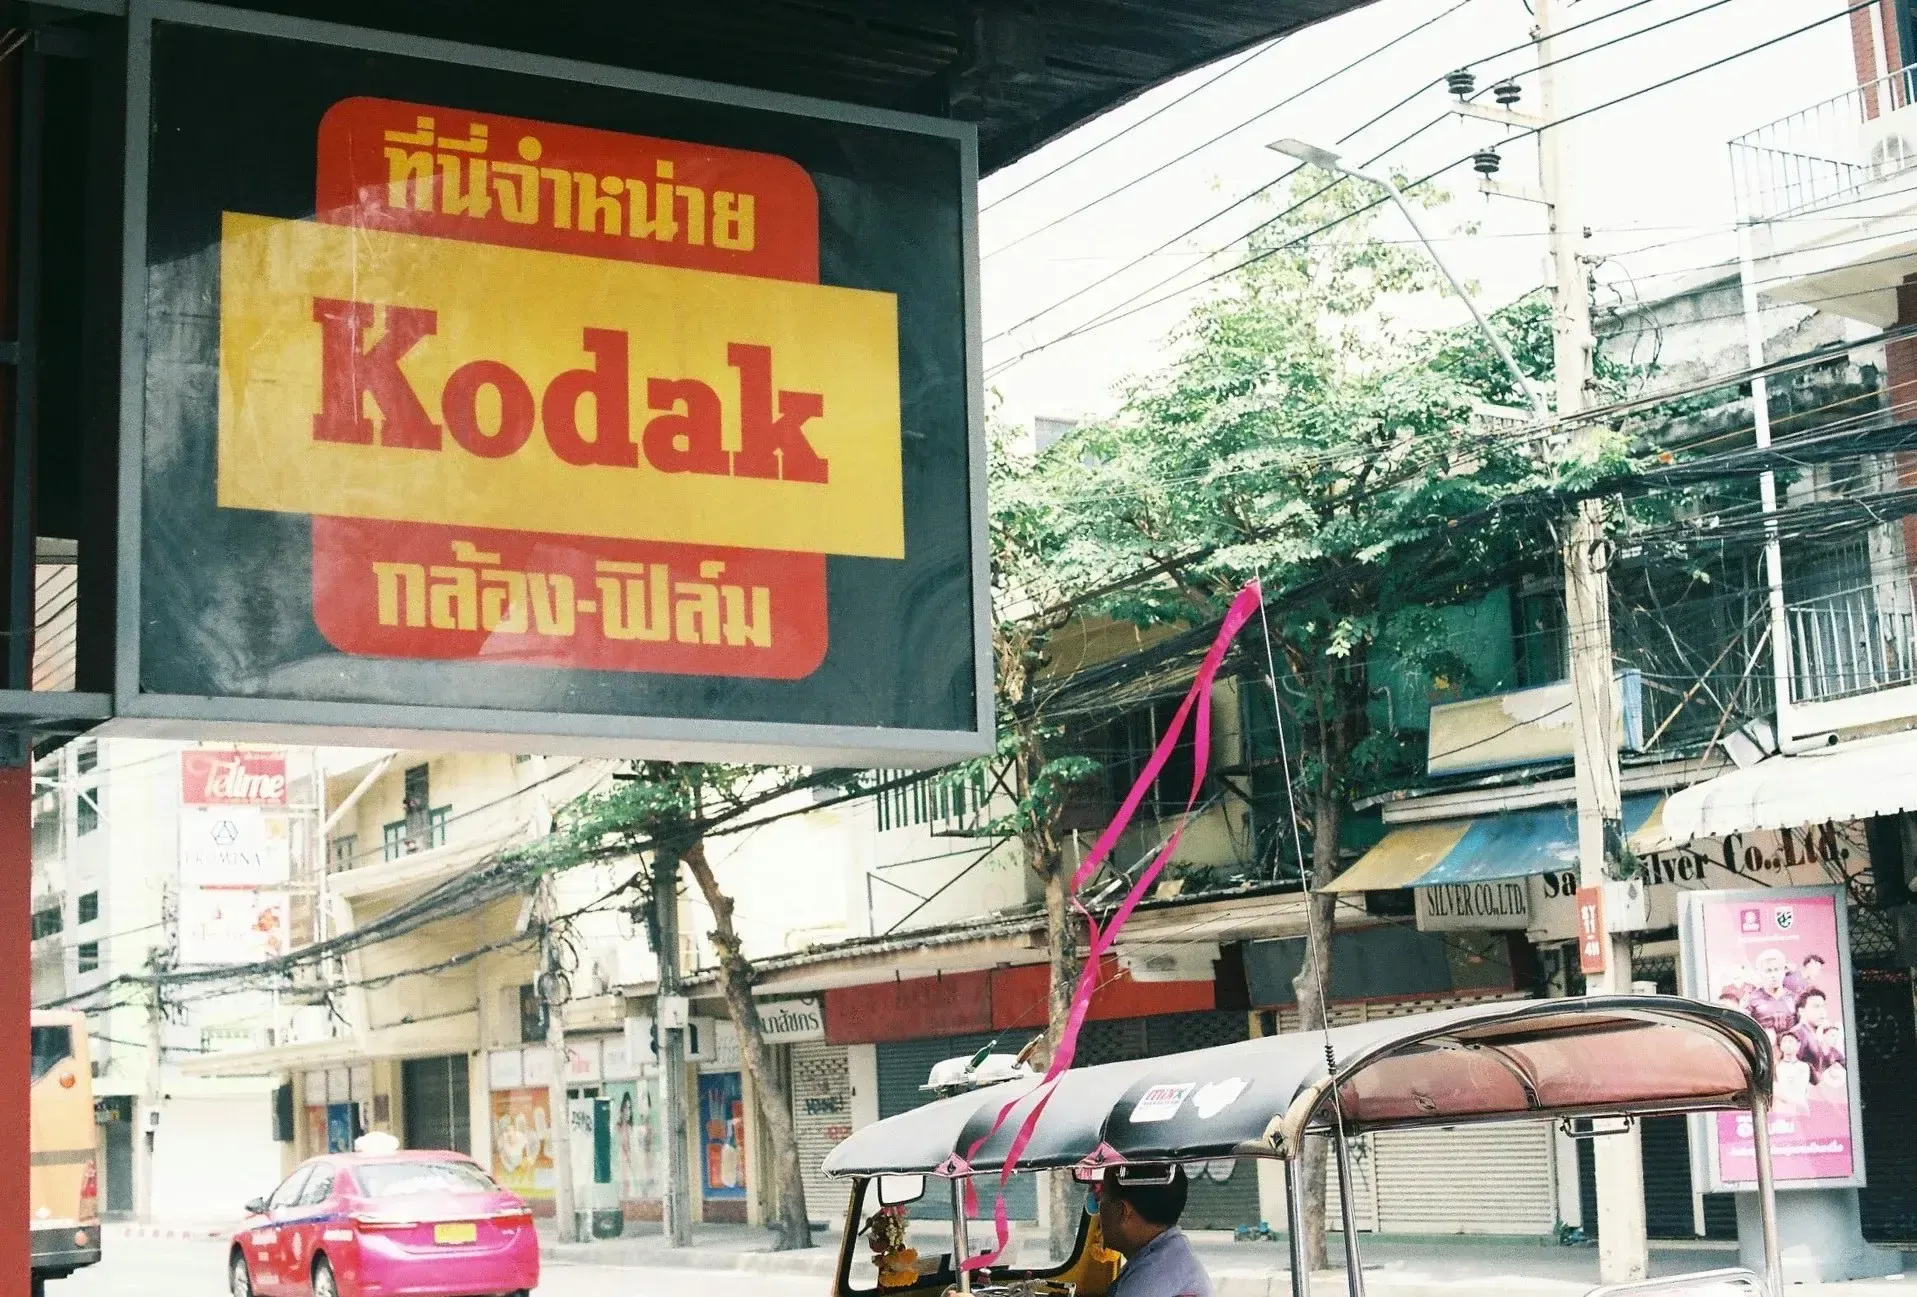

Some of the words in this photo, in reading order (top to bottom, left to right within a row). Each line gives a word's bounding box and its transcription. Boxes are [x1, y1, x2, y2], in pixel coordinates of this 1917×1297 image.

[384, 116, 756, 252] ที่นี่จำหน่าย
[313, 296, 829, 485] Kodak
[372, 541, 772, 648] กล้อง-ฟิล์ม
[1427, 884, 1474, 917] SILVER
